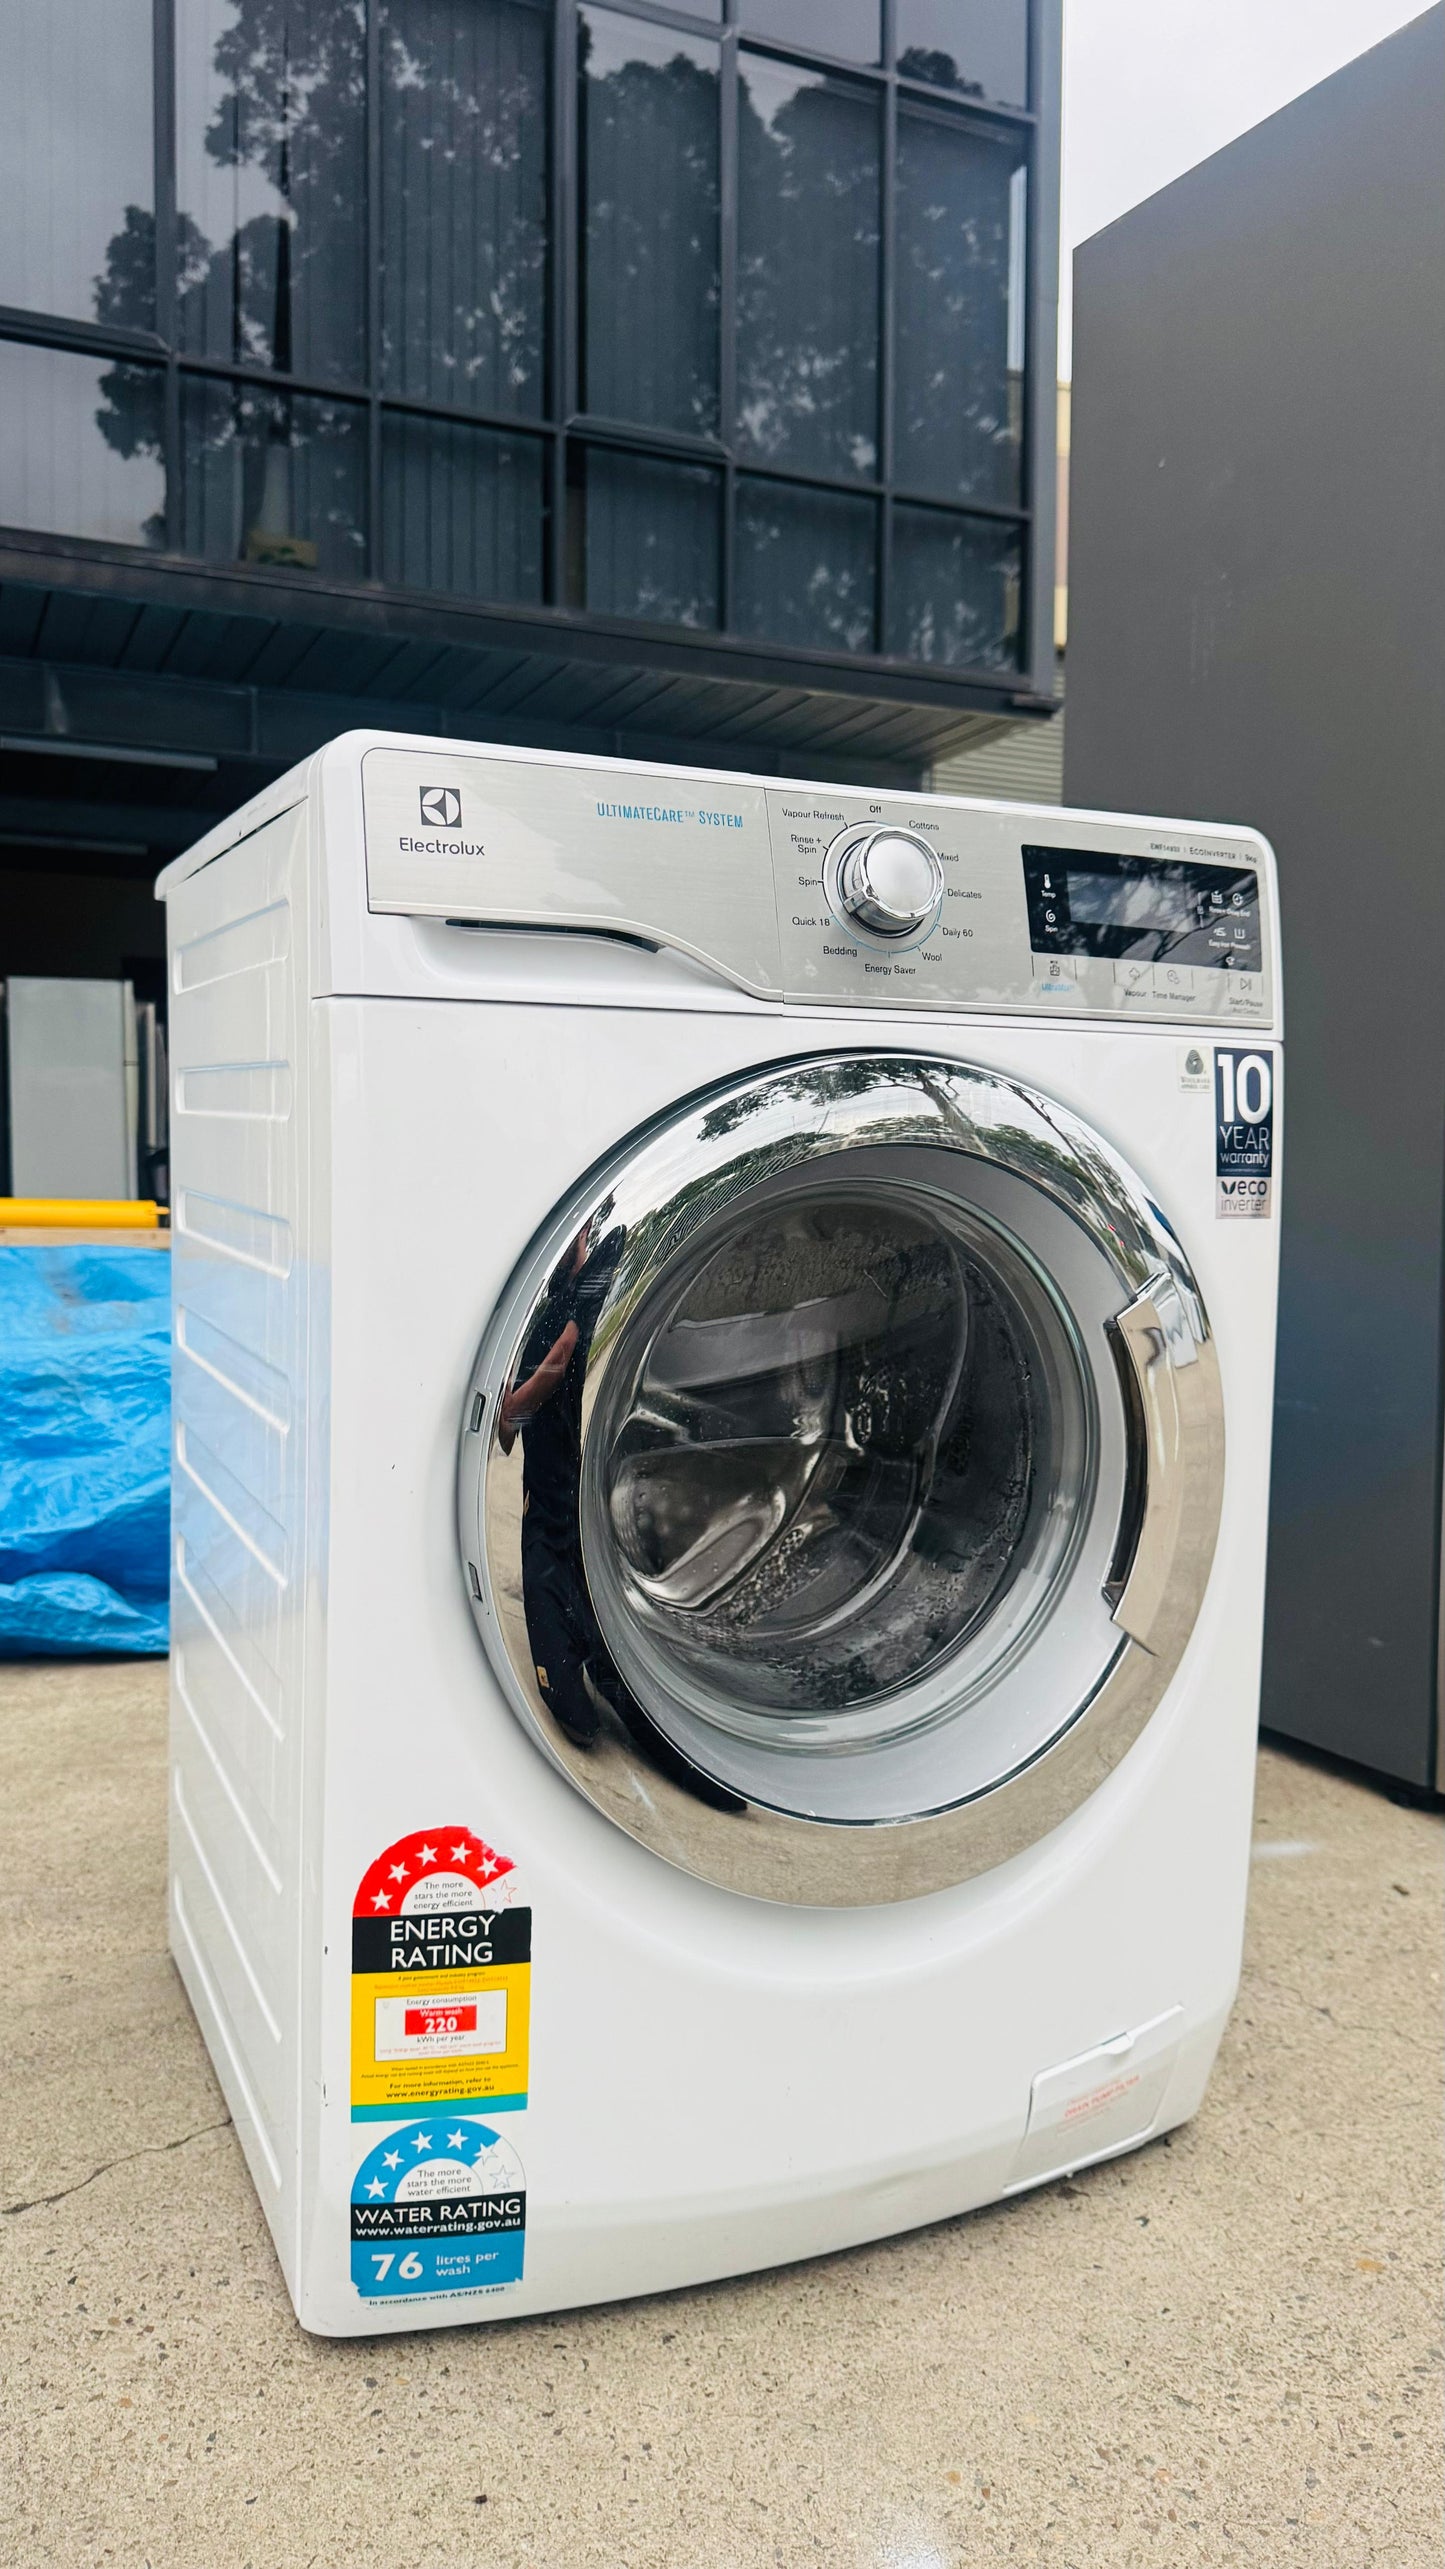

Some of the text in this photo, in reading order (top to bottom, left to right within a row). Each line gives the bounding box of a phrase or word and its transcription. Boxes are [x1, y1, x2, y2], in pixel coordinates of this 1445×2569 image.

[782, 807, 845, 821] Vapour Refresh
[869, 805, 882, 814] Off
[699, 810, 743, 828] SYSTEM
[908, 820, 940, 831] Cottons
[790, 834, 814, 844] Rinse
[399, 836, 485, 857] Electrolux
[797, 844, 817, 854] Spin
[937, 852, 959, 862] Mixed
[798, 877, 817, 886] Spin
[947, 888, 982, 899] Delicates
[1041, 890, 1056, 899] Temp
[792, 917, 830, 927] Quick 18
[942, 928, 974, 939] Daily 60
[1044, 925, 1058, 934] Spin
[823, 946, 857, 957] Bedding
[922, 952, 942, 961] Wool
[864, 964, 916, 975] Energy Saver
[1123, 988, 1147, 998] Vapour
[1152, 990, 1197, 1002] Time Manager
[1217, 1053, 1271, 1125] 10
[1220, 1126, 1270, 1150] YEAR
[1220, 1152, 1270, 1168] warranty
[1237, 1179, 1267, 1195] eco
[1220, 1198, 1267, 1212] inverter
[424, 1881, 464, 1890] The more
[415, 1890, 473, 1900] stars the more
[413, 1899, 473, 1910] energy efficient
[390, 1914, 496, 1942] ENERGY
[391, 1942, 493, 1969] RATING
[406, 1995, 477, 2007] Energy consumption
[420, 2007, 463, 2017] Warm wash
[425, 2017, 458, 2033] 220
[417, 2034, 465, 2044] kWh per year
[386, 2085, 495, 2099] www.energyrating.gov.au
[417, 2168, 461, 2178] The more
[407, 2176, 472, 2188] stars the more
[408, 2185, 471, 2196] water efficient
[355, 2199, 521, 2224] WATER RATING
[355, 2217, 521, 2237] www.waterrating.gov.au
[436, 2252, 499, 2266] litres per
[371, 2252, 424, 2282] 76
[436, 2266, 471, 2277] wash
[379, 2296, 427, 2305] accordance
